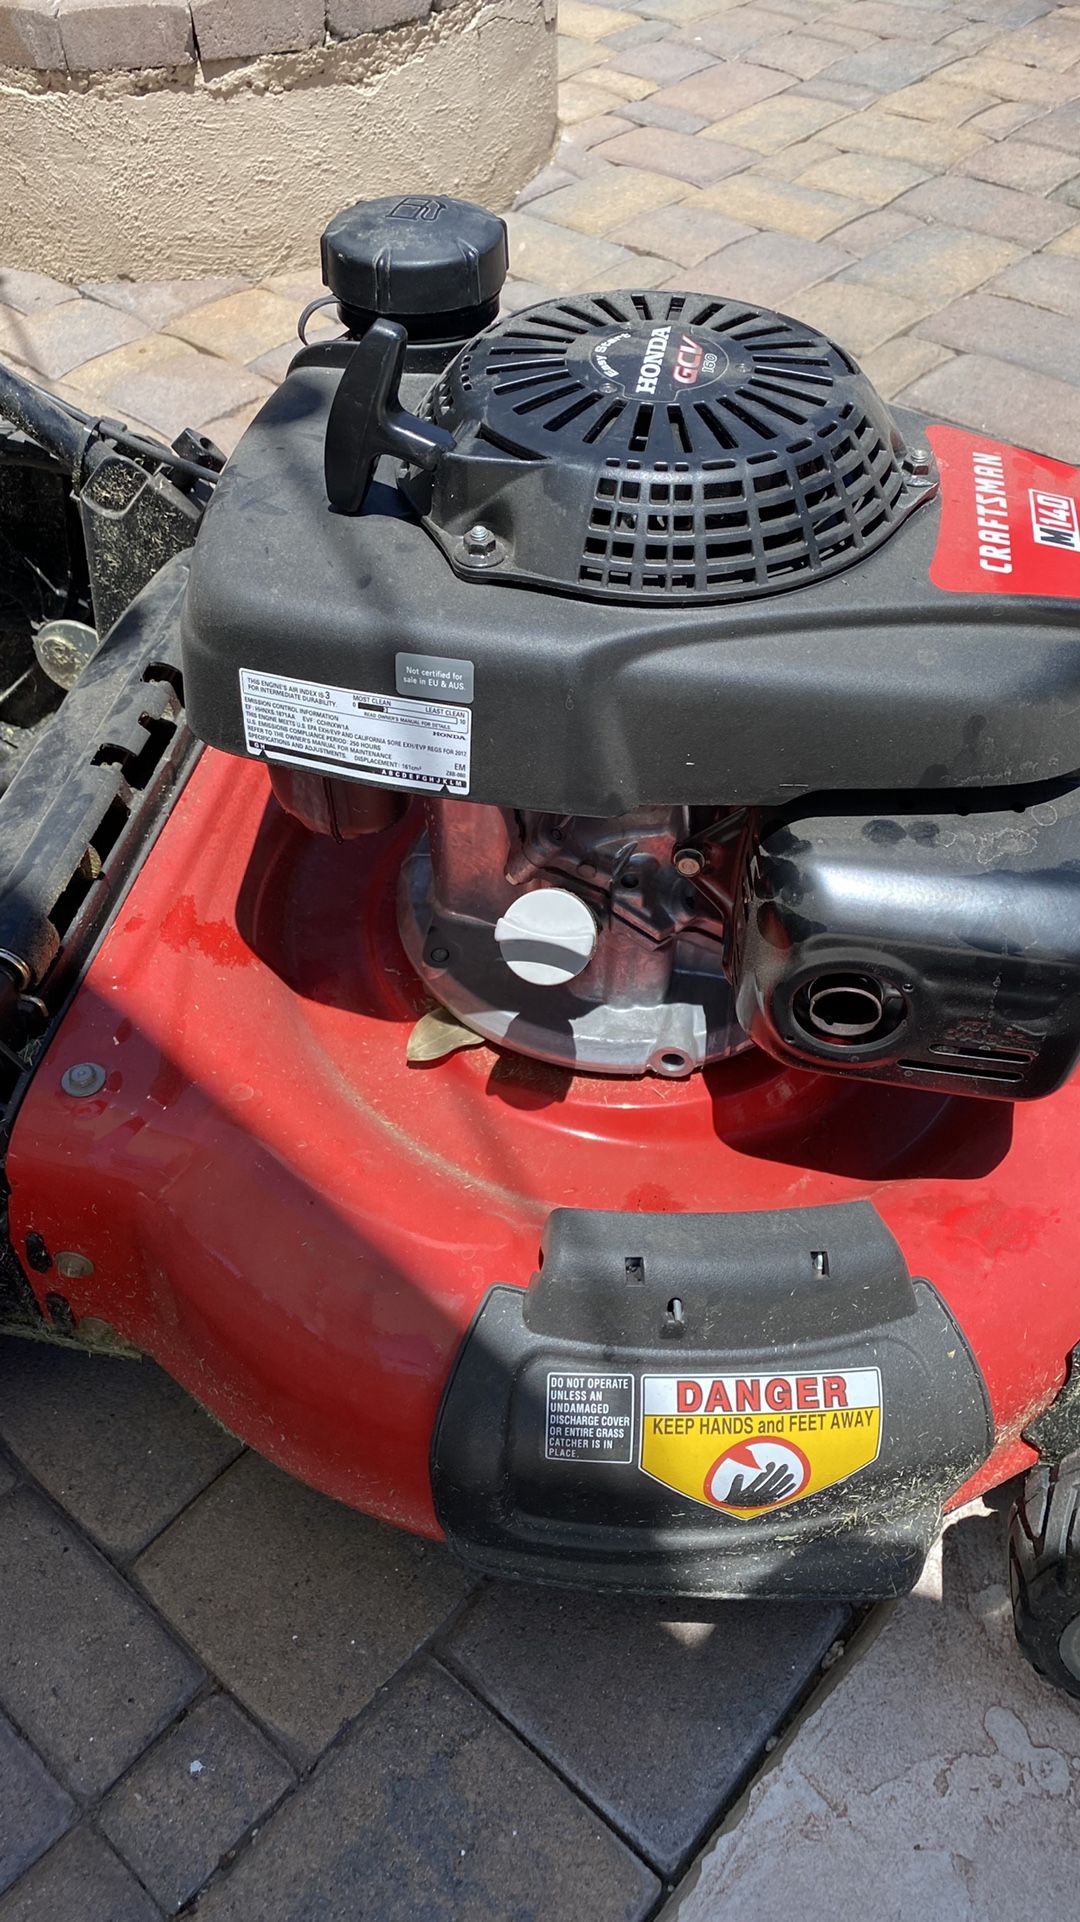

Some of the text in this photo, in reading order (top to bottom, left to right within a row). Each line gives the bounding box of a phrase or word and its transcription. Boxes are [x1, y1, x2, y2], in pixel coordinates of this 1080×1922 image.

[594, 332, 632, 378] Easy Start
[635, 325, 672, 395] HONDA
[673, 335, 703, 385] GCV
[701, 352, 718, 374] 160
[972, 451, 1013, 575] CRAFTSMAN
[1036, 493, 1076, 548] M140
[403, 676, 417, 685] sale
[419, 677, 426, 685] in
[428, 679, 439, 687] EU
[405, 666, 463, 681] Not certified for
[247, 677, 260, 686] THIS
[261, 680, 288, 691] ENGINE'S
[299, 688, 318, 697] INDEX
[318, 691, 325, 699] IS
[325, 690, 331, 700] 3
[248, 683, 259, 691] FOR
[260, 686, 301, 701] INTERMEDIATE
[244, 696, 339, 722] EMISSION CONTROL INFORMATION
[353, 694, 391, 707] MOST CLEAN
[425, 706, 465, 718] LEAST CLEAN
[246, 711, 257, 719] THIS
[258, 713, 277, 723] ENGINE
[278, 717, 296, 727] MEETS
[342, 731, 354, 739] AND
[354, 733, 386, 745] CALIFORNIA
[427, 745, 442, 753] REGS
[247, 732, 291, 748] SPECIFICATIONS
[291, 742, 304, 750] AND
[258, 720, 289, 733] EMISSIONS
[289, 727, 325, 740] COMPLIANCE
[360, 742, 381, 752] HOURS
[432, 731, 466, 741] HONDA
[247, 725, 264, 734] REFER
[274, 731, 284, 739] THE
[285, 733, 311, 745] OWNER'S
[312, 739, 336, 750] MANUAL
[337, 744, 349, 753] FOR
[350, 747, 392, 760] MAINTENANCE
[454, 763, 466, 773] EM
[550, 1377, 629, 1389] DO NOT OPERATE
[550, 1390, 603, 1401] UNLESS AN
[676, 1375, 849, 1414] DANGER
[550, 1402, 609, 1414] UNDAMAGED
[550, 1414, 630, 1427] DISCHARGE COVER
[653, 1410, 874, 1436] KEEP HANDS and FEET AWAY
[549, 1426, 624, 1438] OR ENTIRE GRASS
[549, 1437, 613, 1449] CATCHER IS IN
[548, 1448, 579, 1458] PLACE.
